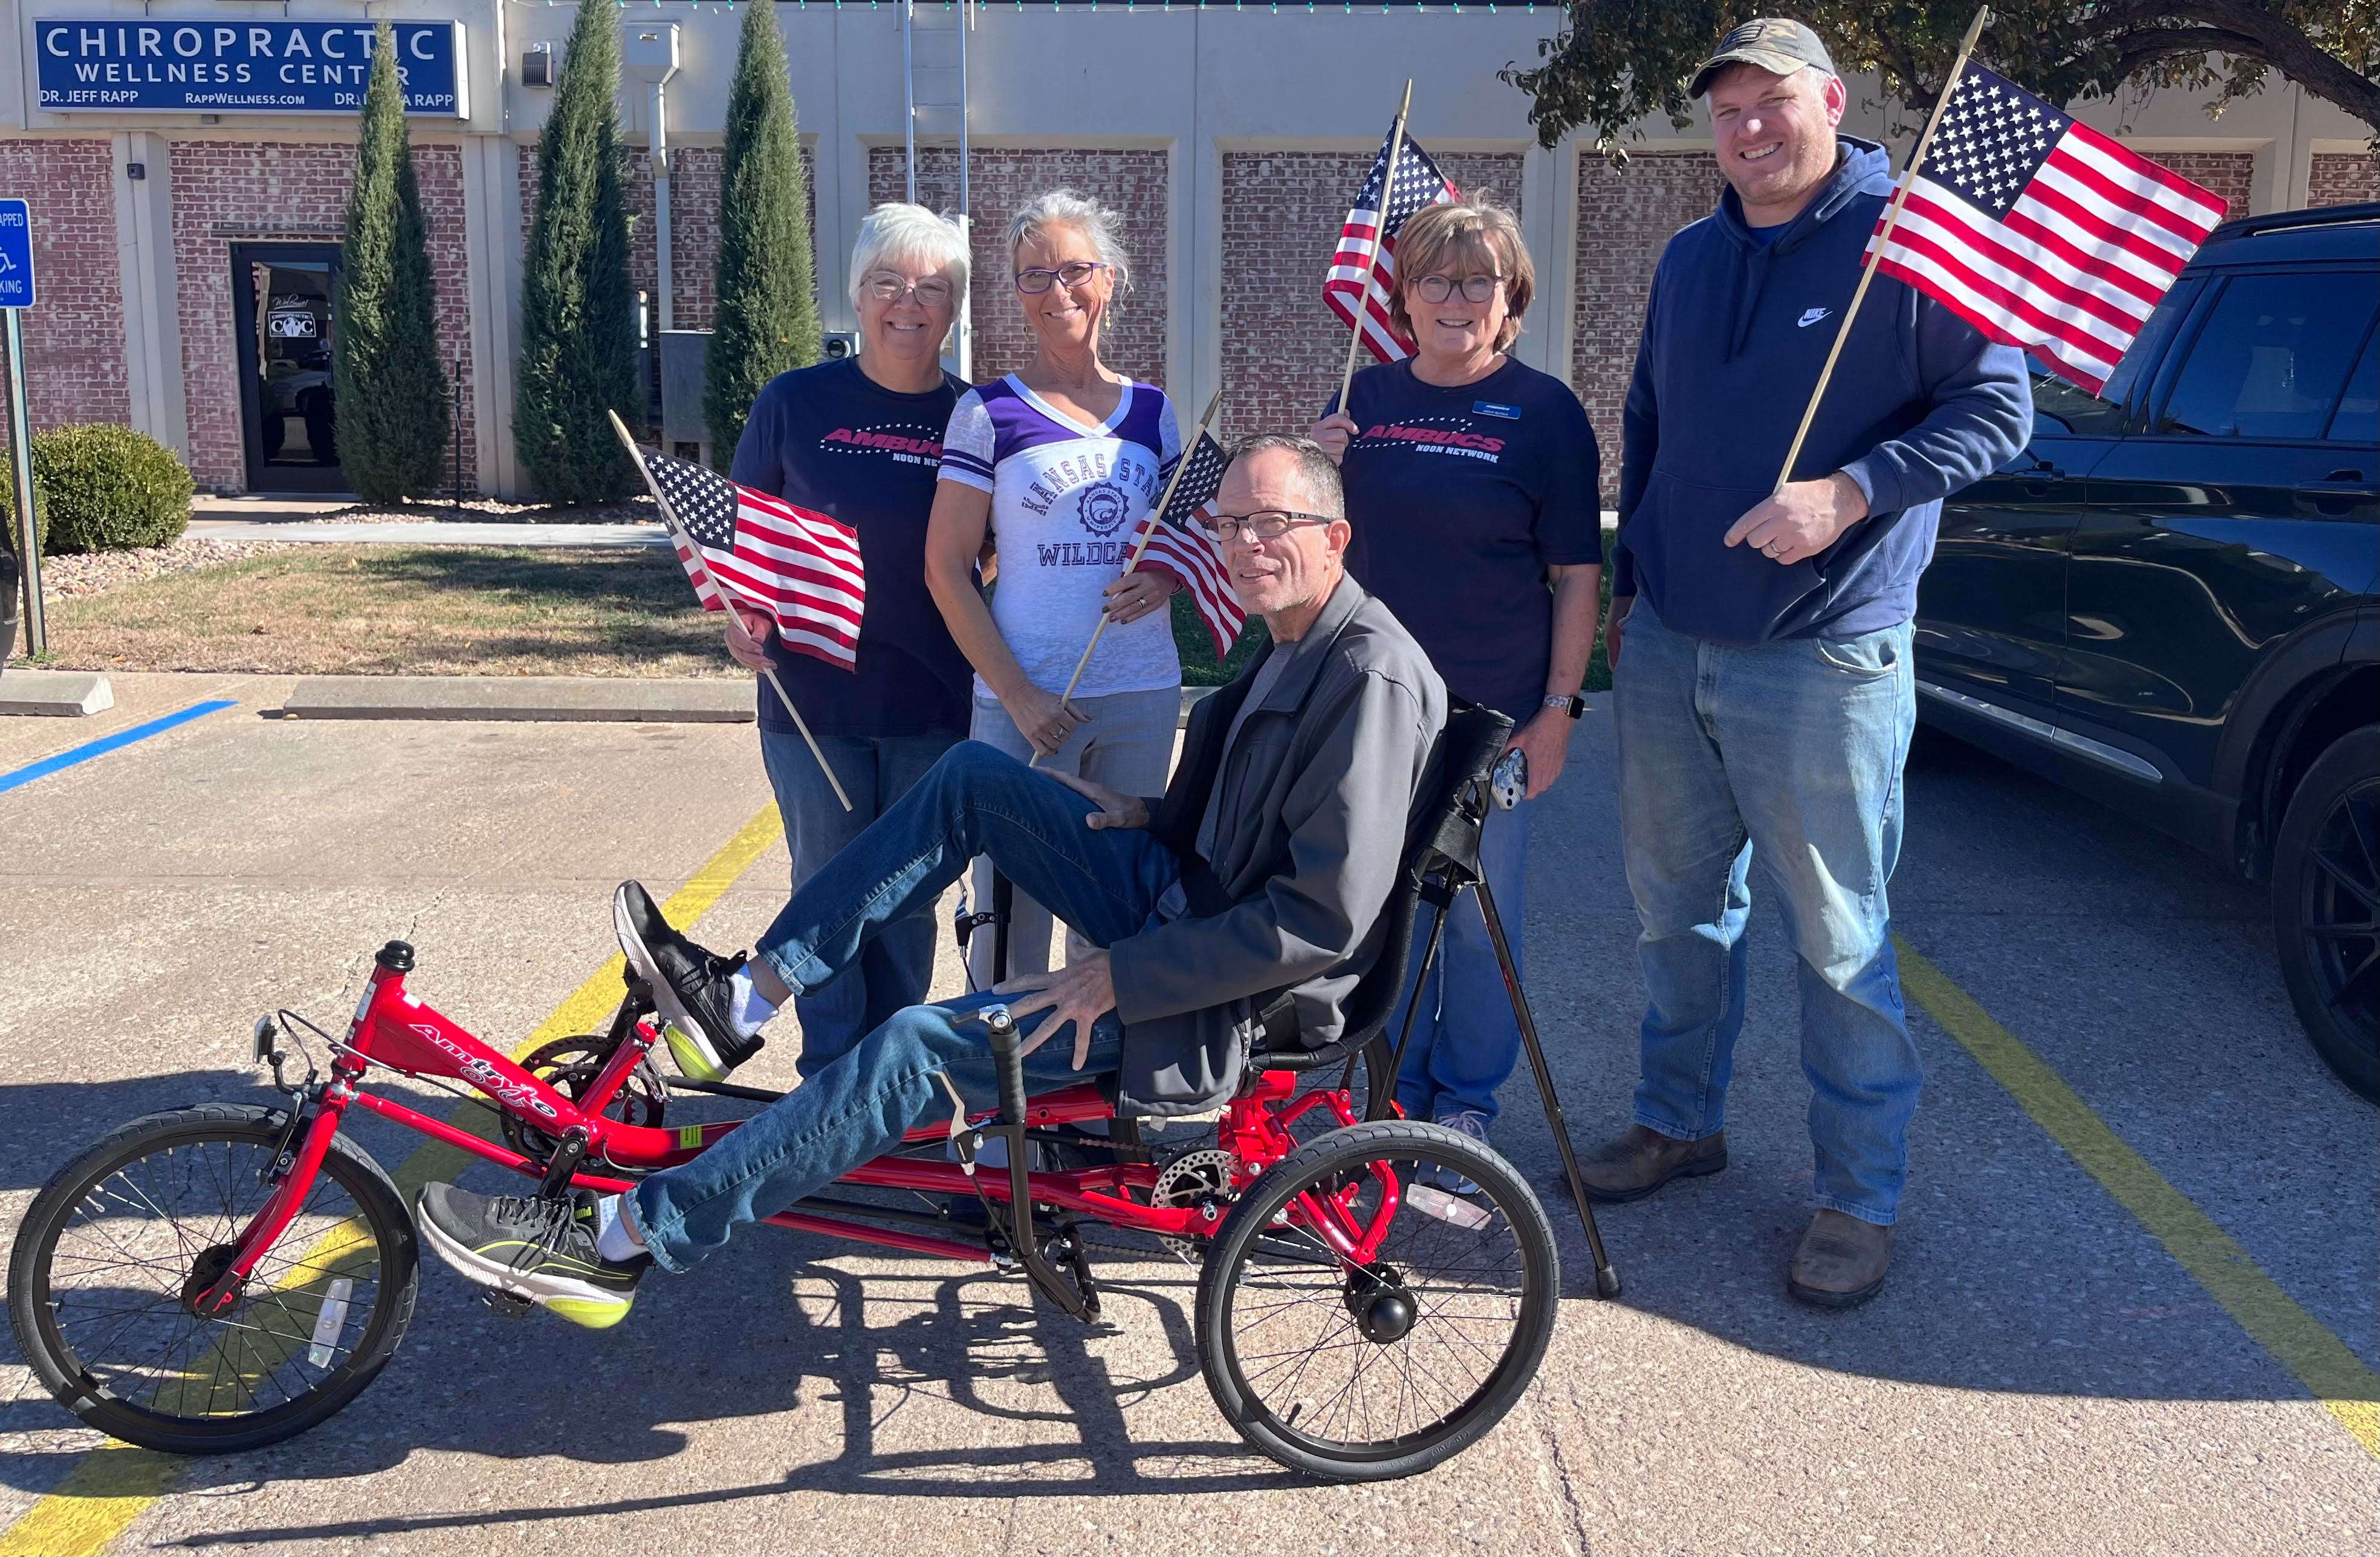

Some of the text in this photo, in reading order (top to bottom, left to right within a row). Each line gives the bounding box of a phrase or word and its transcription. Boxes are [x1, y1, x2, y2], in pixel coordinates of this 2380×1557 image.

[46, 27, 435, 60] CHIROPRACTIC
[75, 63, 410, 86] WELLNESS CENTR
[40, 89, 139, 103] DR. JEFF RAPP
[415, 94, 453, 107] RAPP
[1803, 307, 1826, 320] NIKE
[1361, 424, 1506, 452] AMBUCS
[893, 453, 922, 465] NOON
[1415, 444, 1499, 464] NOON NETWORK
[1022, 453, 1158, 516] KANSAS STA
